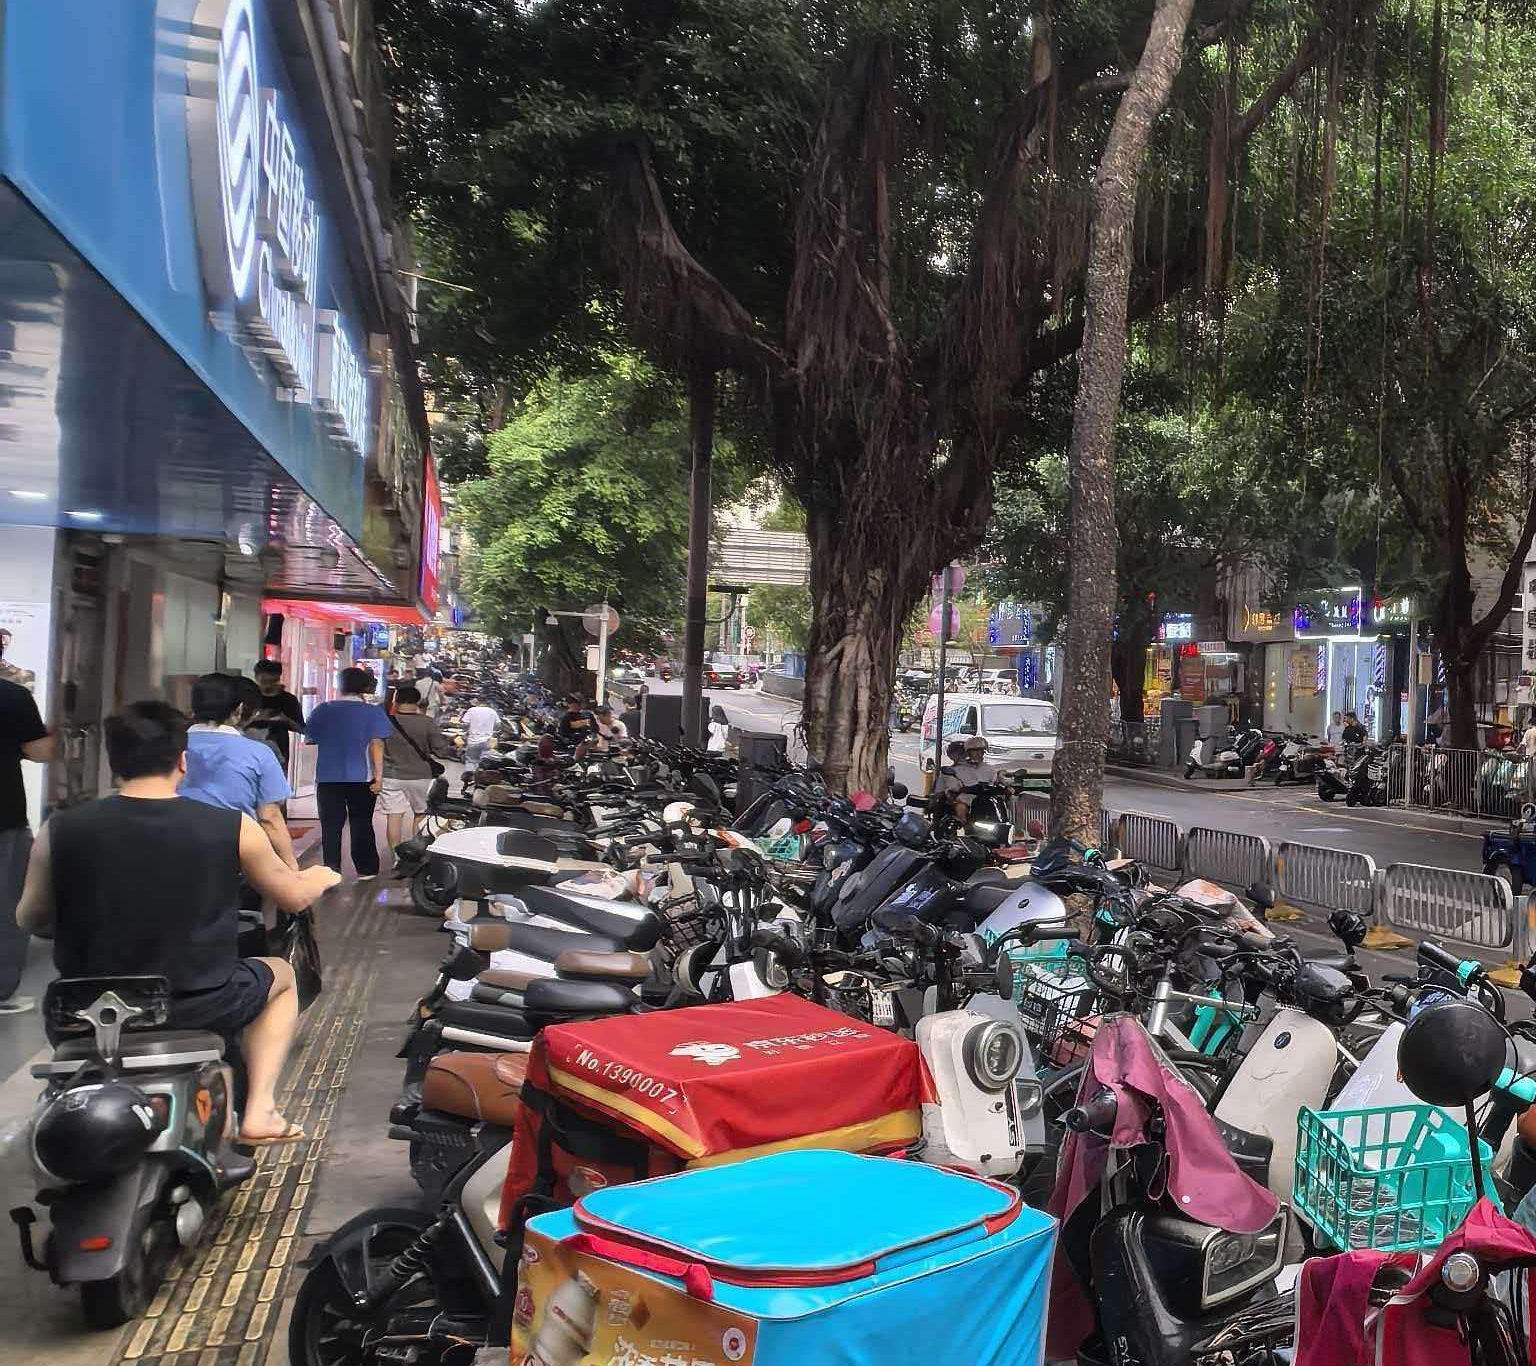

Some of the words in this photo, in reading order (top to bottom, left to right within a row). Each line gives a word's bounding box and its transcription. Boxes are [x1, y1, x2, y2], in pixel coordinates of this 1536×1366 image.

[263, 88, 316, 305] 中国移动
[574, 1047, 679, 1105] No.1390007
